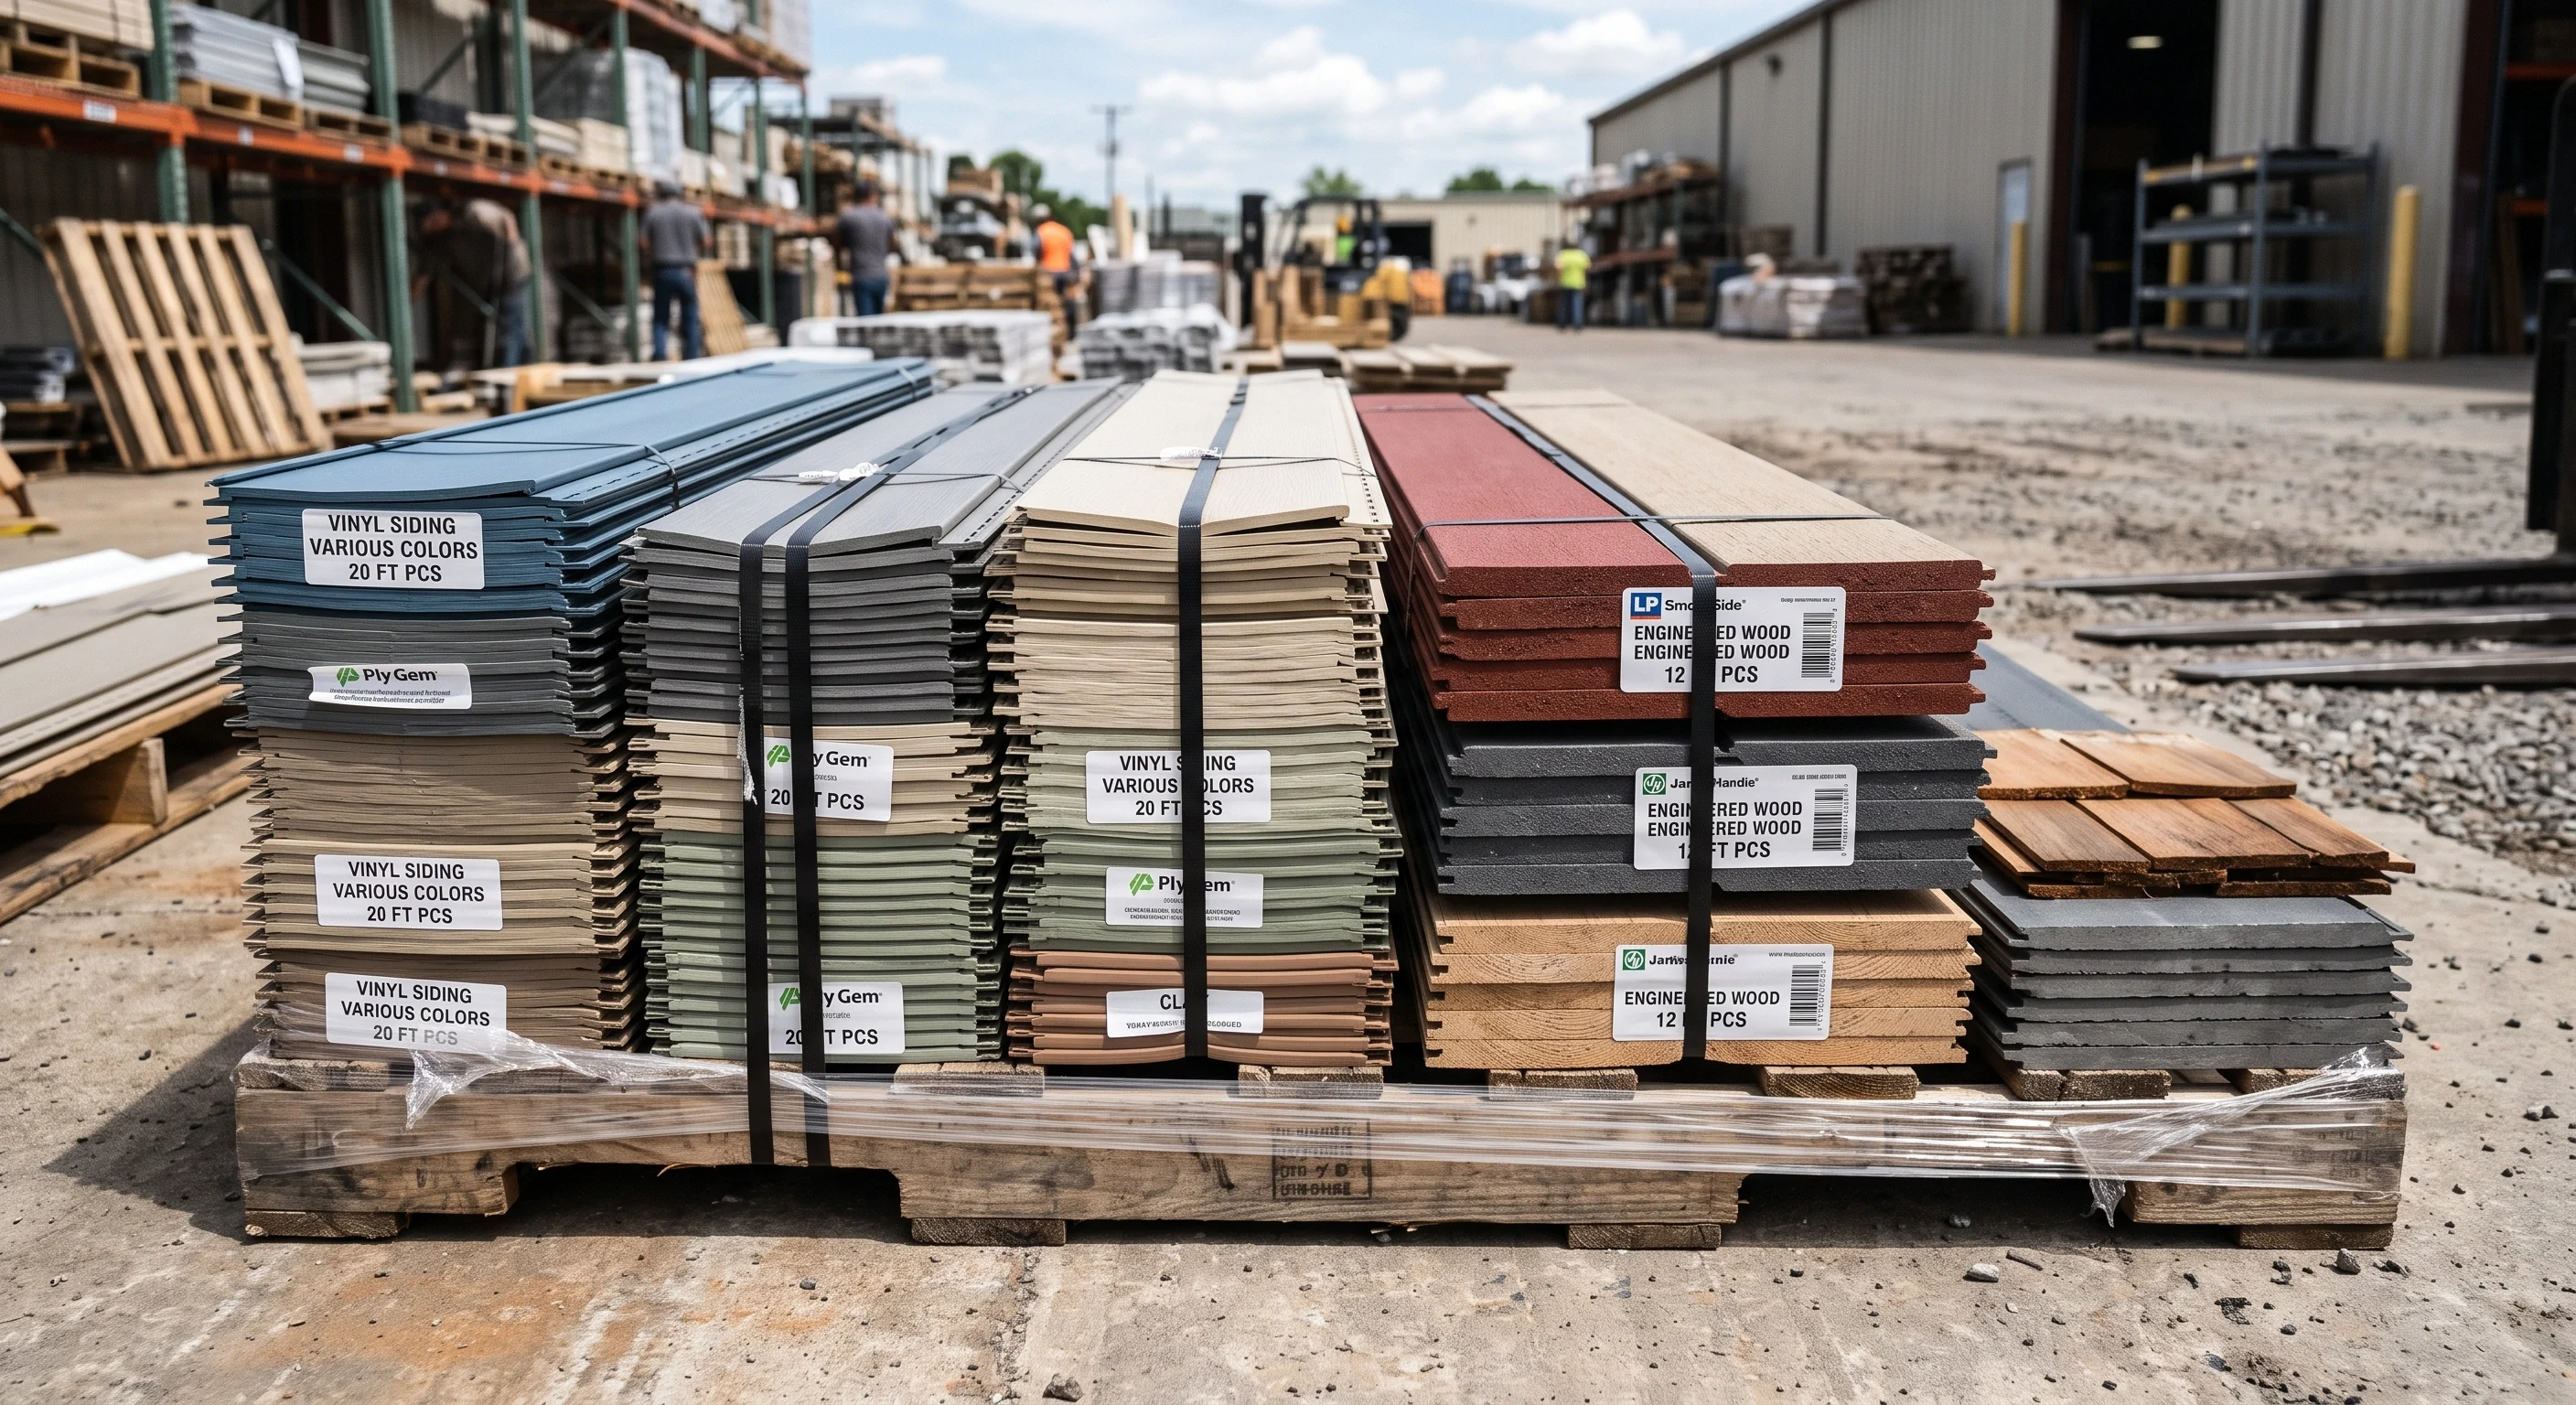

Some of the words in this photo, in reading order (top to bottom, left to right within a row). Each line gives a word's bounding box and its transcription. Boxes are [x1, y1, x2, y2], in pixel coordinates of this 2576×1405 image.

[327, 514, 385, 533] VINYL
[390, 515, 456, 535] SIDING
[308, 537, 394, 558] VARIOUS
[400, 540, 478, 560] COLORS
[349, 563, 370, 581] 20
[376, 563, 399, 581] FT
[404, 563, 442, 583] PCS
[1634, 596, 1659, 612] LP
[1634, 625, 1736, 640] ENGINEED
[1741, 625, 1791, 640] WOOD
[1634, 644, 1735, 660] ENGINEED
[1740, 644, 1790, 660] WOOD
[362, 668, 392, 685] Ply
[393, 668, 437, 681] Gem
[1664, 666, 1685, 683] 12
[1721, 665, 1758, 683] PCS
[825, 751, 867, 767] Gem
[1119, 755, 1172, 771] VINYL
[1176, 755, 1236, 771] ING
[1101, 778, 1178, 794] VARIOUS
[1203, 778, 1254, 794] LORS
[770, 788, 791, 806] 20
[827, 792, 864, 810] PCS
[1135, 799, 1155, 816] 20
[1161, 799, 1182, 816] FT
[1203, 799, 1223, 816] CS
[1648, 801, 1749, 818] ENGIRED
[1754, 800, 1803, 817] WOOD
[1648, 820, 1747, 837] ENGIRED
[1752, 820, 1802, 835] WOOD
[1734, 841, 1771, 859] PCS
[347, 861, 401, 878] VINYL
[404, 862, 465, 880] SIDING
[332, 883, 409, 900] VARIOUS
[413, 885, 485, 902] COLORS
[1158, 875, 1184, 896] Ply
[1205, 880, 1230, 892] em
[367, 906, 386, 922] 20
[392, 906, 413, 923] FT
[418, 906, 453, 924] PCS
[356, 980, 408, 999] VINYL
[413, 984, 472, 1003] SIDING
[837, 989, 879, 1004] Gem
[1625, 991, 1727, 1005] ENGINEED
[1731, 991, 1780, 1005] WOOD
[340, 1000, 415, 1021] VARIOUS
[420, 1006, 490, 1027] COLORS
[1657, 1011, 1677, 1028] 12
[1710, 1011, 1747, 1028] PCS
[373, 1024, 393, 1041] 20
[398, 1026, 418, 1043] FT
[424, 1029, 458, 1046] PCS
[842, 1028, 879, 1046] PCS
